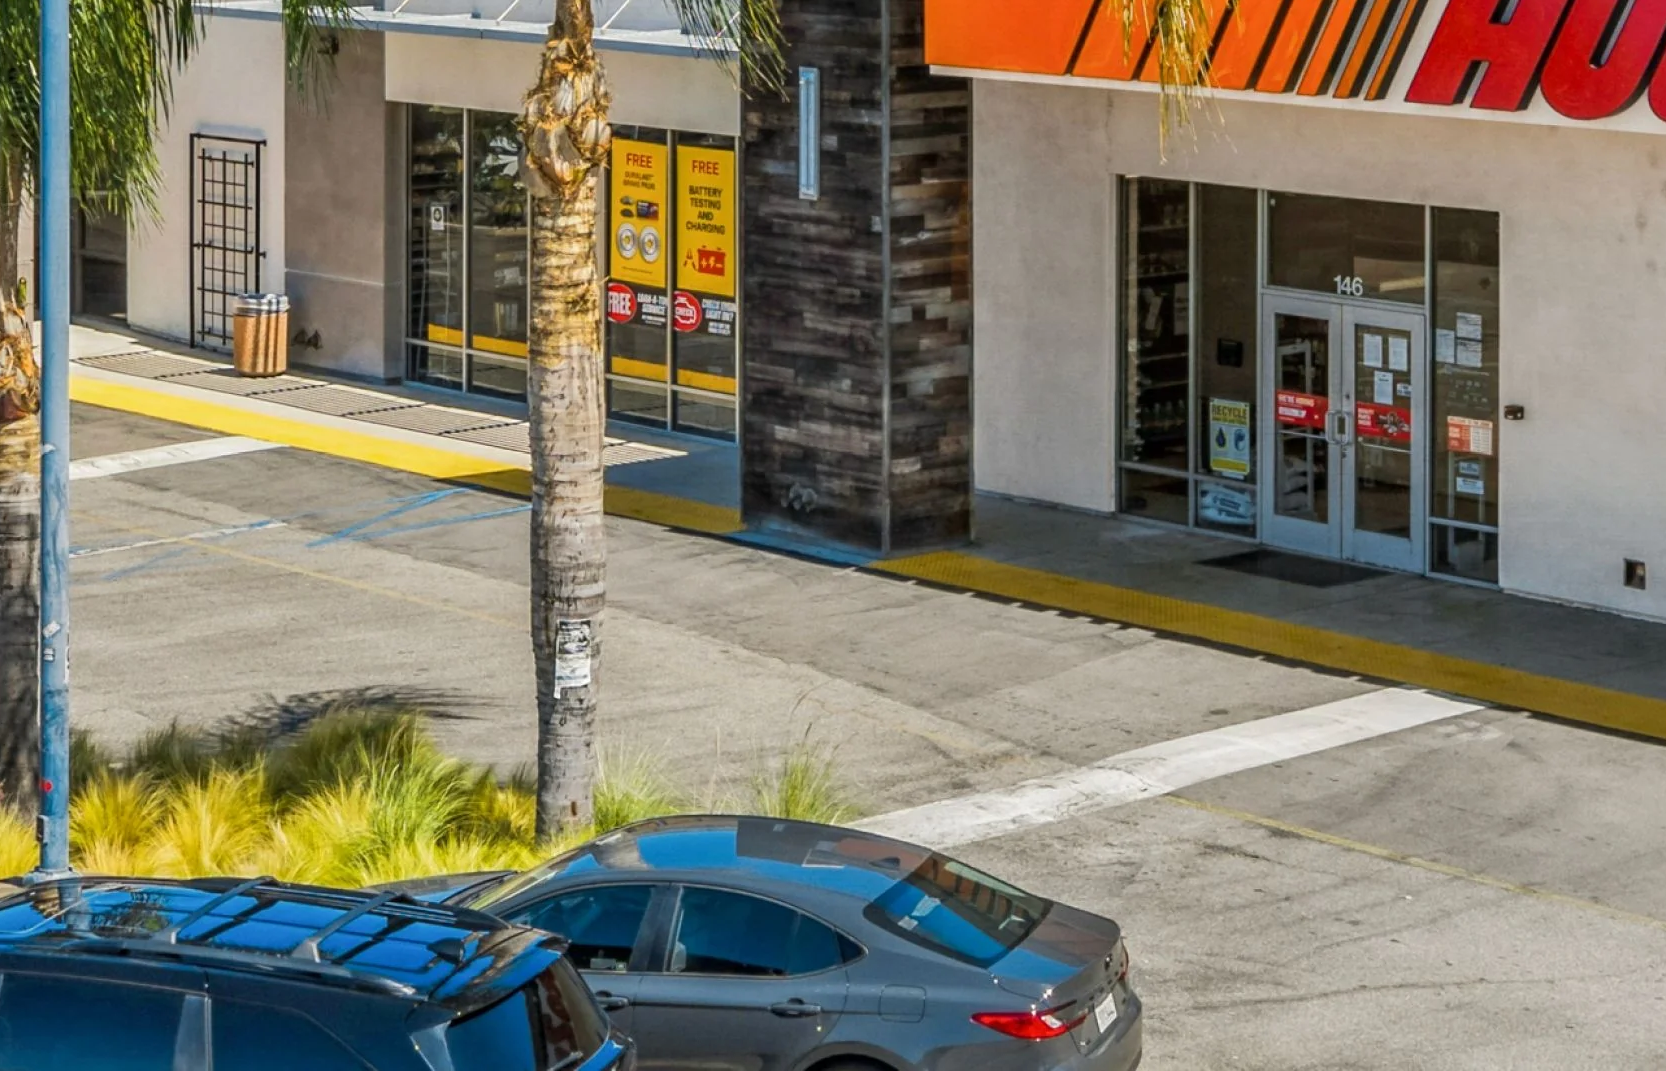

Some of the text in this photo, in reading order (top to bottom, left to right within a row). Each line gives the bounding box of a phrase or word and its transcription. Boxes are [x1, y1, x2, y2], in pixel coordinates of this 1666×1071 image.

[625, 152, 653, 169] FREE
[692, 159, 720, 176] FREE
[689, 185, 723, 198] BATTERY
[690, 197, 721, 211] TESTING
[697, 211, 714, 221] AND
[686, 220, 726, 235] CHARGING
[1333, 274, 1364, 296] 146
[608, 291, 631, 316] FREE
[1212, 404, 1247, 419] RECYCLE
